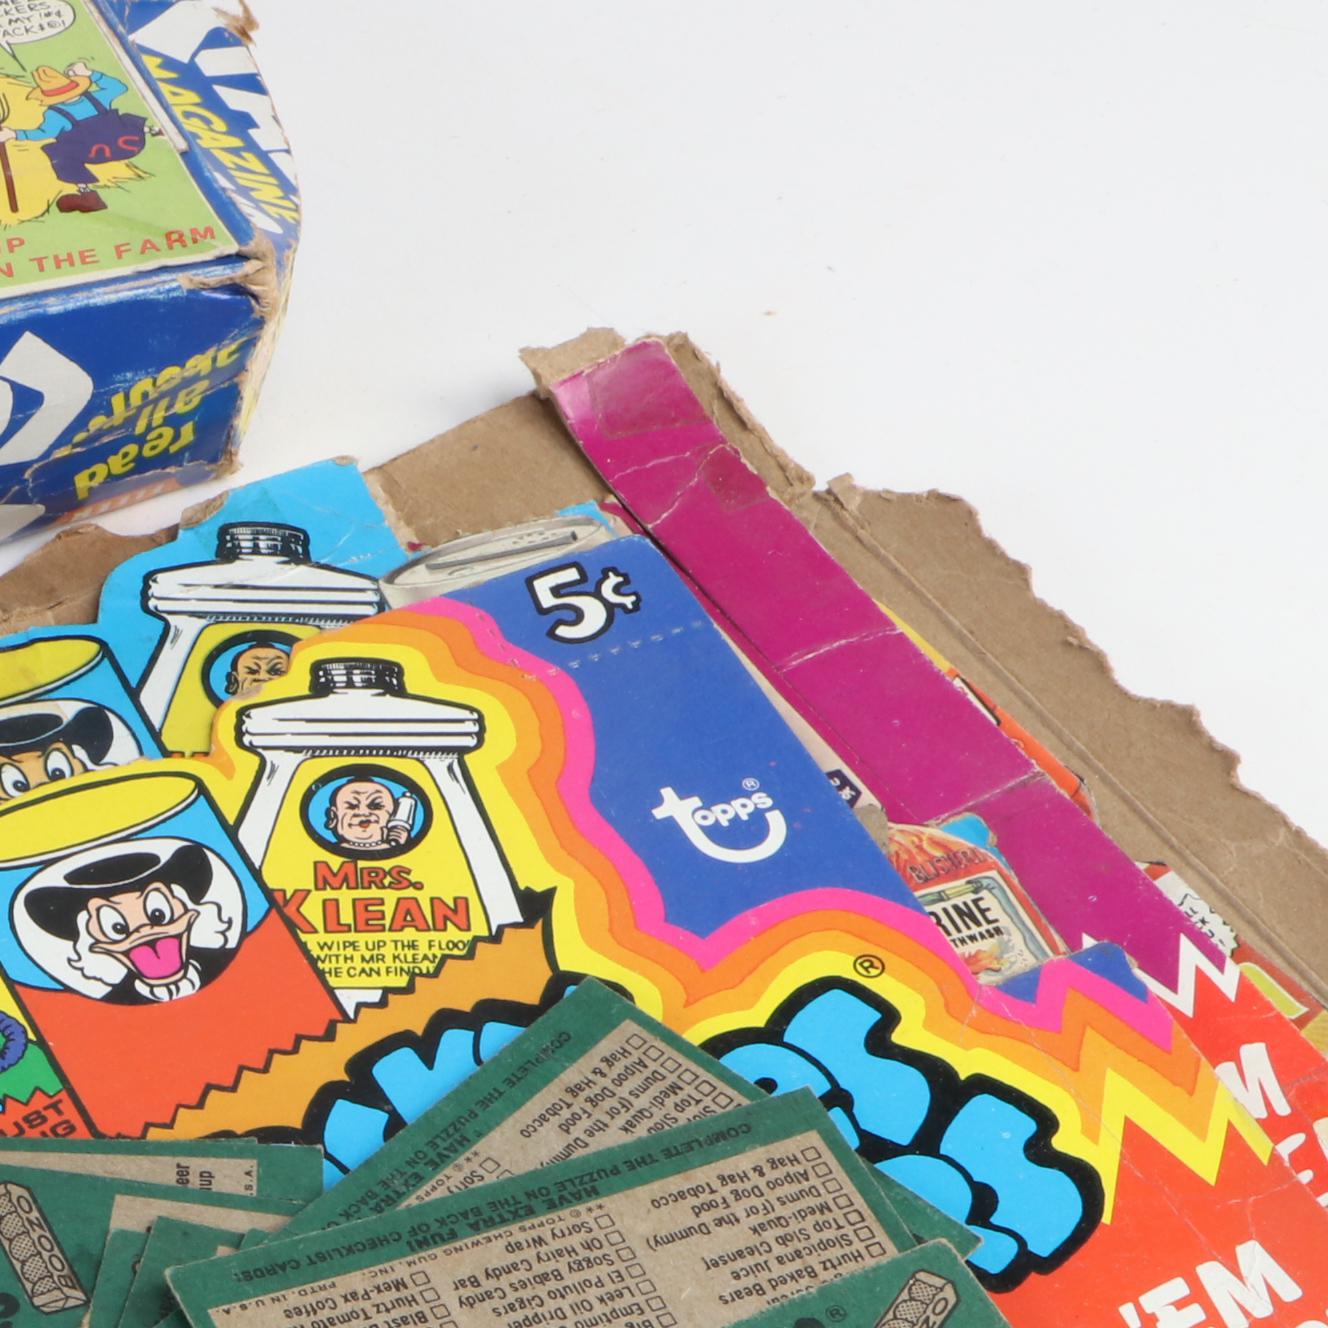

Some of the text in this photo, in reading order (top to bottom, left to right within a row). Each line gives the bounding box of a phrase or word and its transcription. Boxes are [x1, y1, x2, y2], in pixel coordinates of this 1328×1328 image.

[30, 247, 100, 274] THE
[114, 224, 217, 261] FARM
[74, 422, 196, 500] read
[651, 786, 788, 864] topps
[272, 888, 472, 934] KLEAN
[316, 939, 362, 952] WIPE
[365, 939, 387, 952] UP
[390, 939, 420, 952] THE
